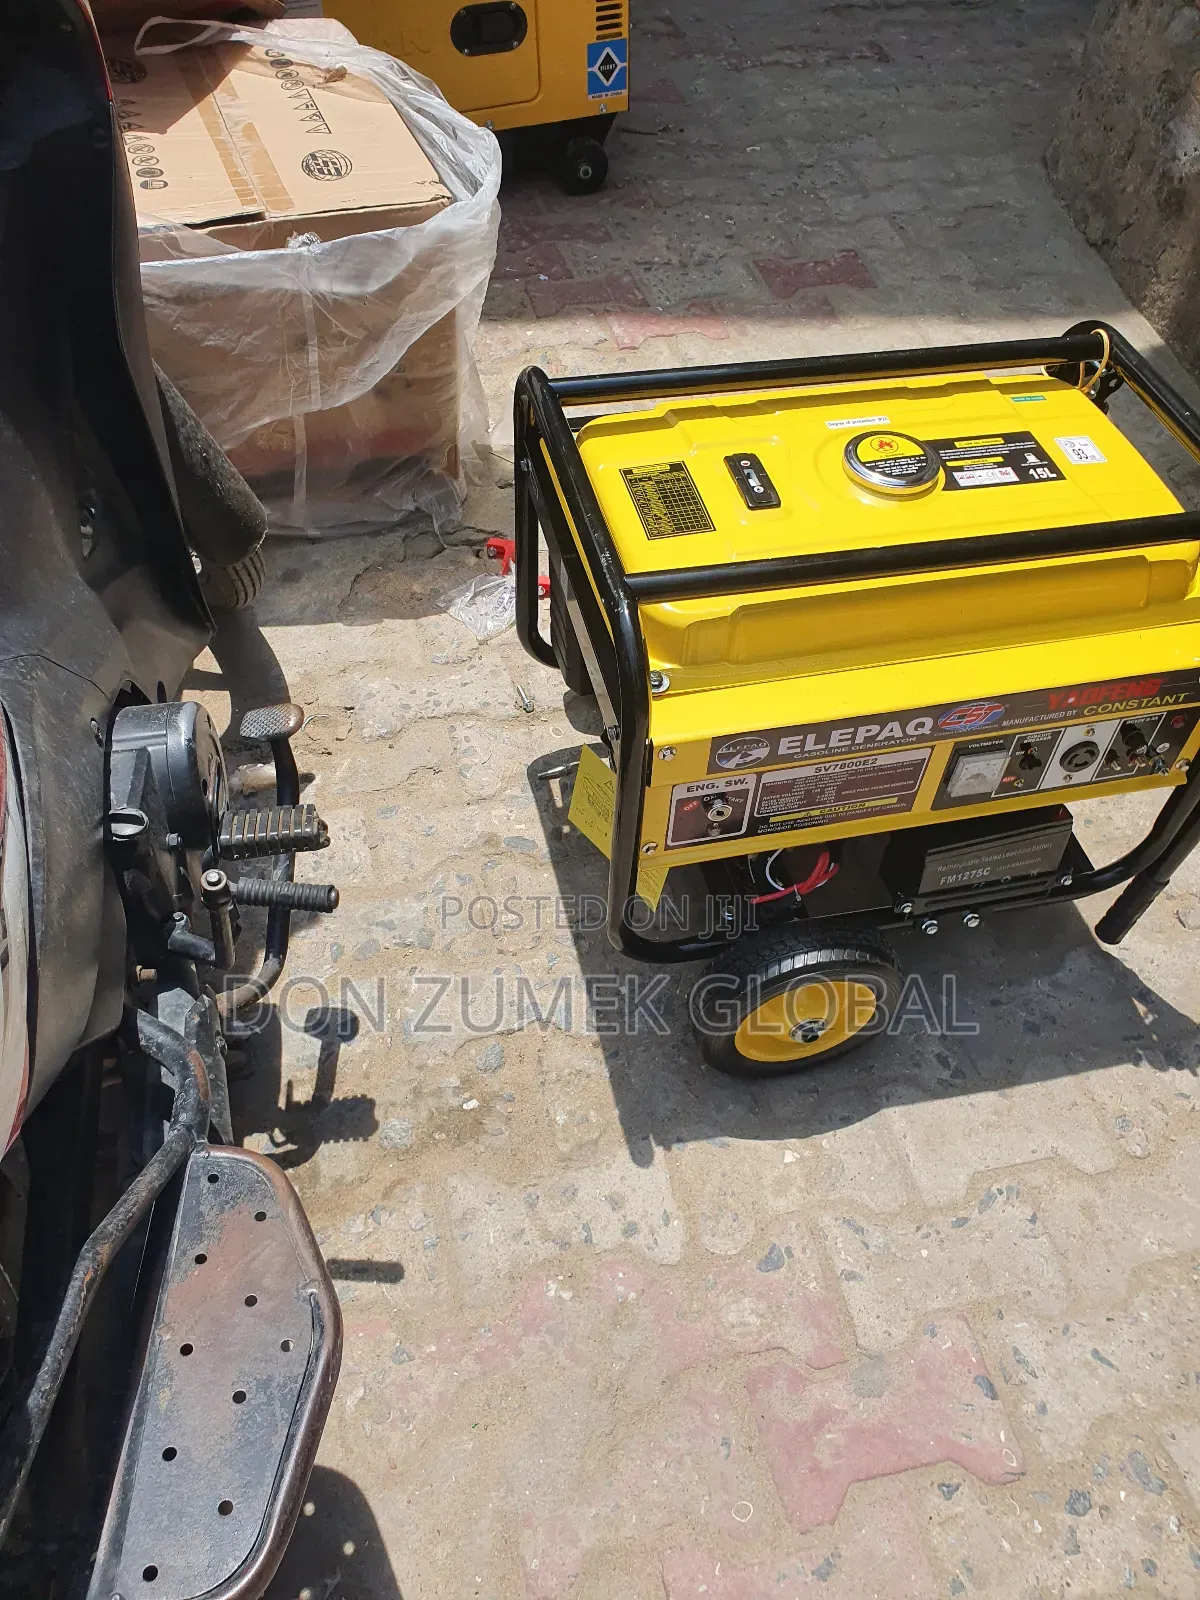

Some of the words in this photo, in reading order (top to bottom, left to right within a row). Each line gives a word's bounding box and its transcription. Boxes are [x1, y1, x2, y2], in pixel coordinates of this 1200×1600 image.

[1072, 448, 1088, 460] 93
[1028, 468, 1057, 480] 15L
[1084, 692, 1189, 716] CONSTANT
[938, 702, 1005, 726] CST
[1002, 710, 1065, 727] MANUFACTURED
[1066, 710, 1078, 718] BY
[778, 717, 934, 756] ELEPAQ
[968, 739, 1004, 749] VOLTMETER
[720, 742, 767, 753] ELEPAQ
[794, 746, 849, 759] GASOLINE
[852, 736, 917, 752] GENERATOR
[814, 758, 878, 774] SV7800E2
[686, 782, 720, 793] ENG.
[724, 778, 749, 788] SW.
[684, 801, 699, 811] OFF
[820, 802, 866, 814] CAUTION
[940, 866, 990, 885] FM1275C
